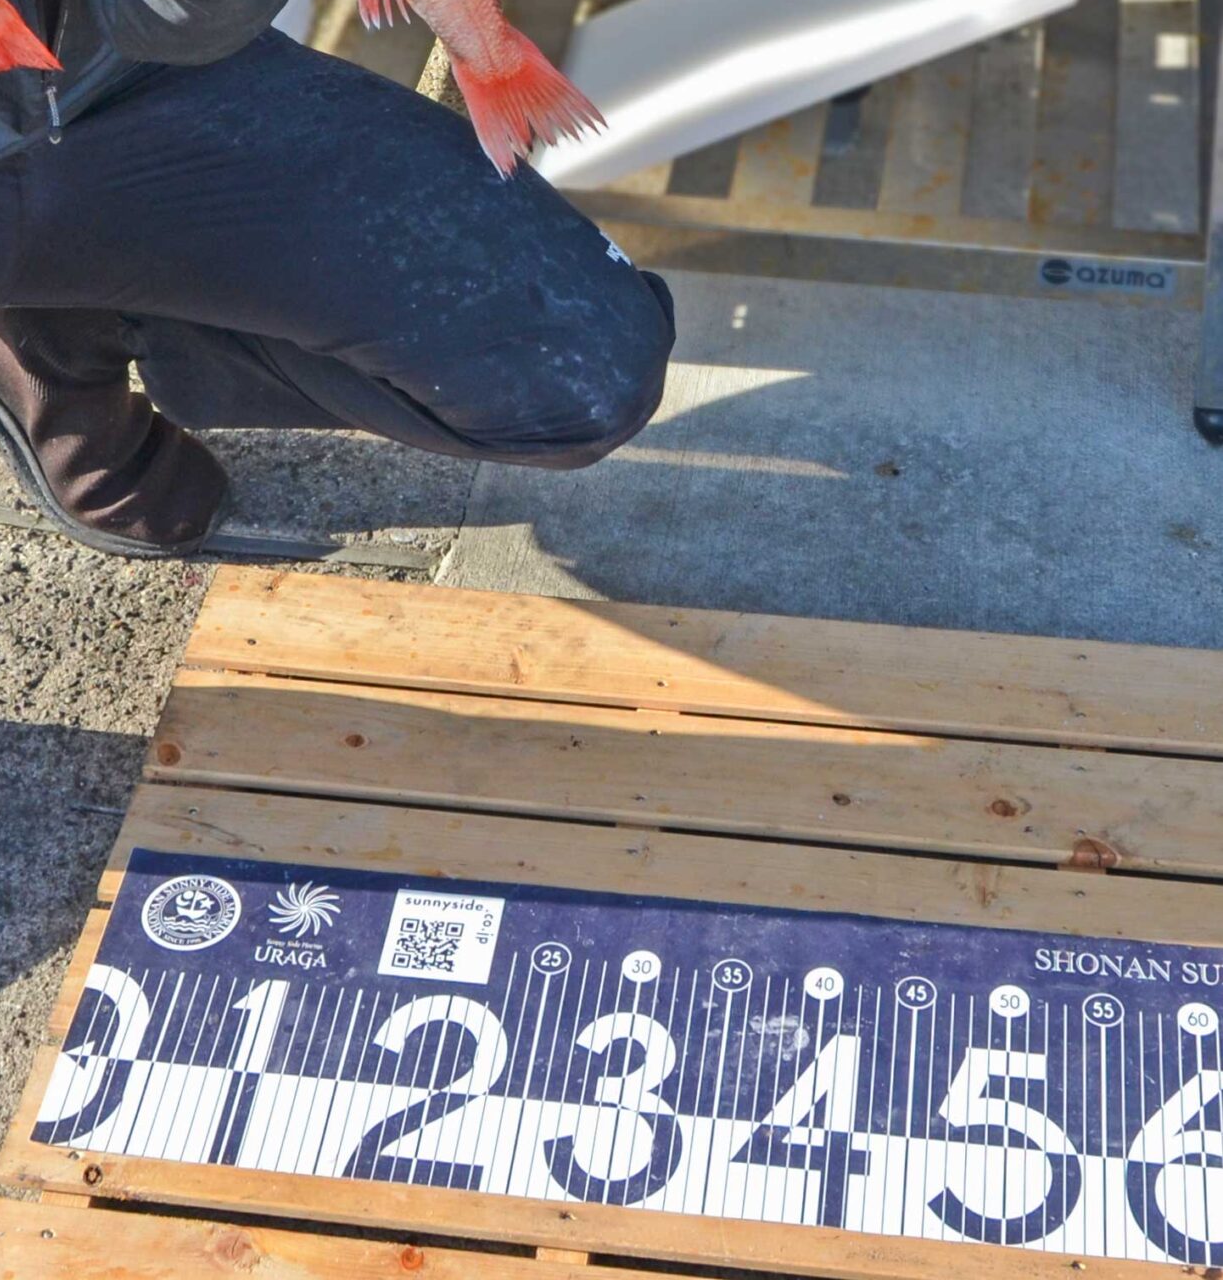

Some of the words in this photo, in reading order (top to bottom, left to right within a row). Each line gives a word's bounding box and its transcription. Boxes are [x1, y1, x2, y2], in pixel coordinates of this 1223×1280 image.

[1077, 267, 1165, 289] azuma
[163, 879, 207, 896] SUNNY
[254, 945, 327, 970] URAGA
[541, 950, 562, 967] 25
[632, 960, 652, 974] 30
[722, 967, 743, 984] 35
[1035, 948, 1171, 982] SHONAN
[1182, 962, 1223, 986] SU
[815, 977, 834, 991] 40
[906, 985, 927, 1002] 45
[1000, 994, 1020, 1010] 50
[1093, 1001, 1114, 1019] 55
[1188, 1012, 1209, 1028] 60
[208, 978, 291, 1167] 1
[342, 994, 509, 1191] 2
[542, 1012, 684, 1207] 3
[729, 1035, 872, 1228] 4
[927, 1047, 1082, 1246] 5
